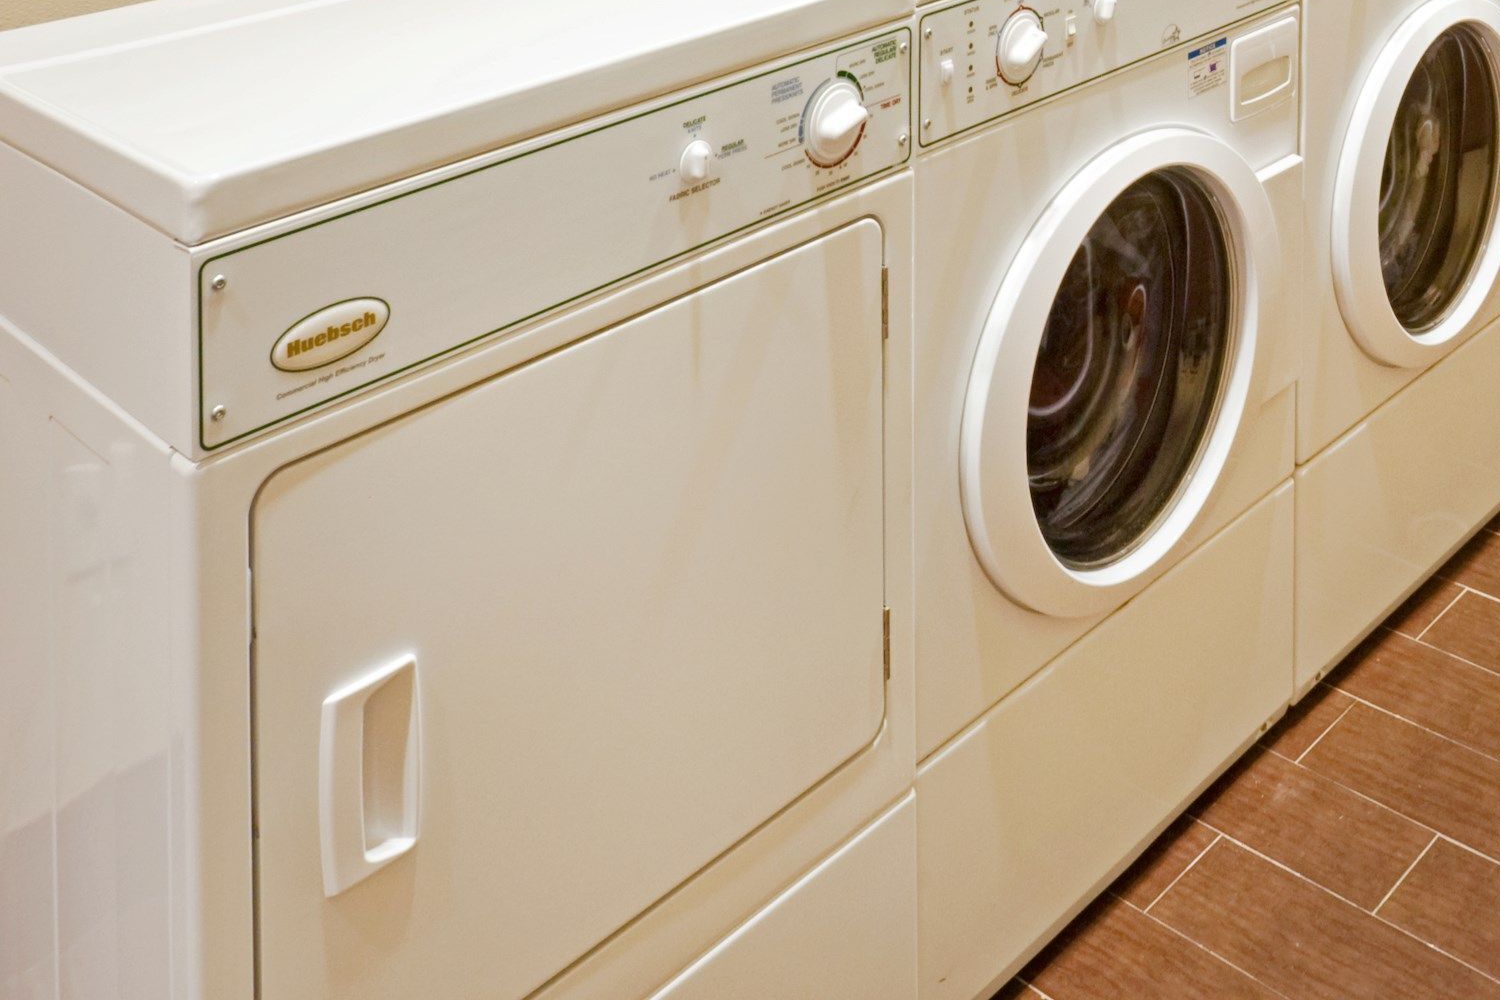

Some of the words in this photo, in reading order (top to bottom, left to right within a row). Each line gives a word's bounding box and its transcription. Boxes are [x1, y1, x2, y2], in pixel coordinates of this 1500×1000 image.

[871, 38, 897, 53] AUTOMATIC
[873, 45, 897, 58] REGULAR
[875, 52, 897, 65] DELICATE
[771, 75, 801, 92] AUTOMATIC
[880, 101, 891, 110] TIME
[891, 97, 902, 107] DRY
[682, 115, 706, 129] DELICATE
[721, 138, 745, 152] REGULAR
[657, 168, 672, 179] HEAT
[668, 188, 690, 203] FABRIC
[690, 178, 721, 194] SELECTOR
[286, 312, 376, 358] Huebsch
[276, 379, 316, 400] Commercial
[318, 372, 334, 385] High
[334, 361, 367, 377] Efficiency
[368, 353, 386, 365] Dryer
